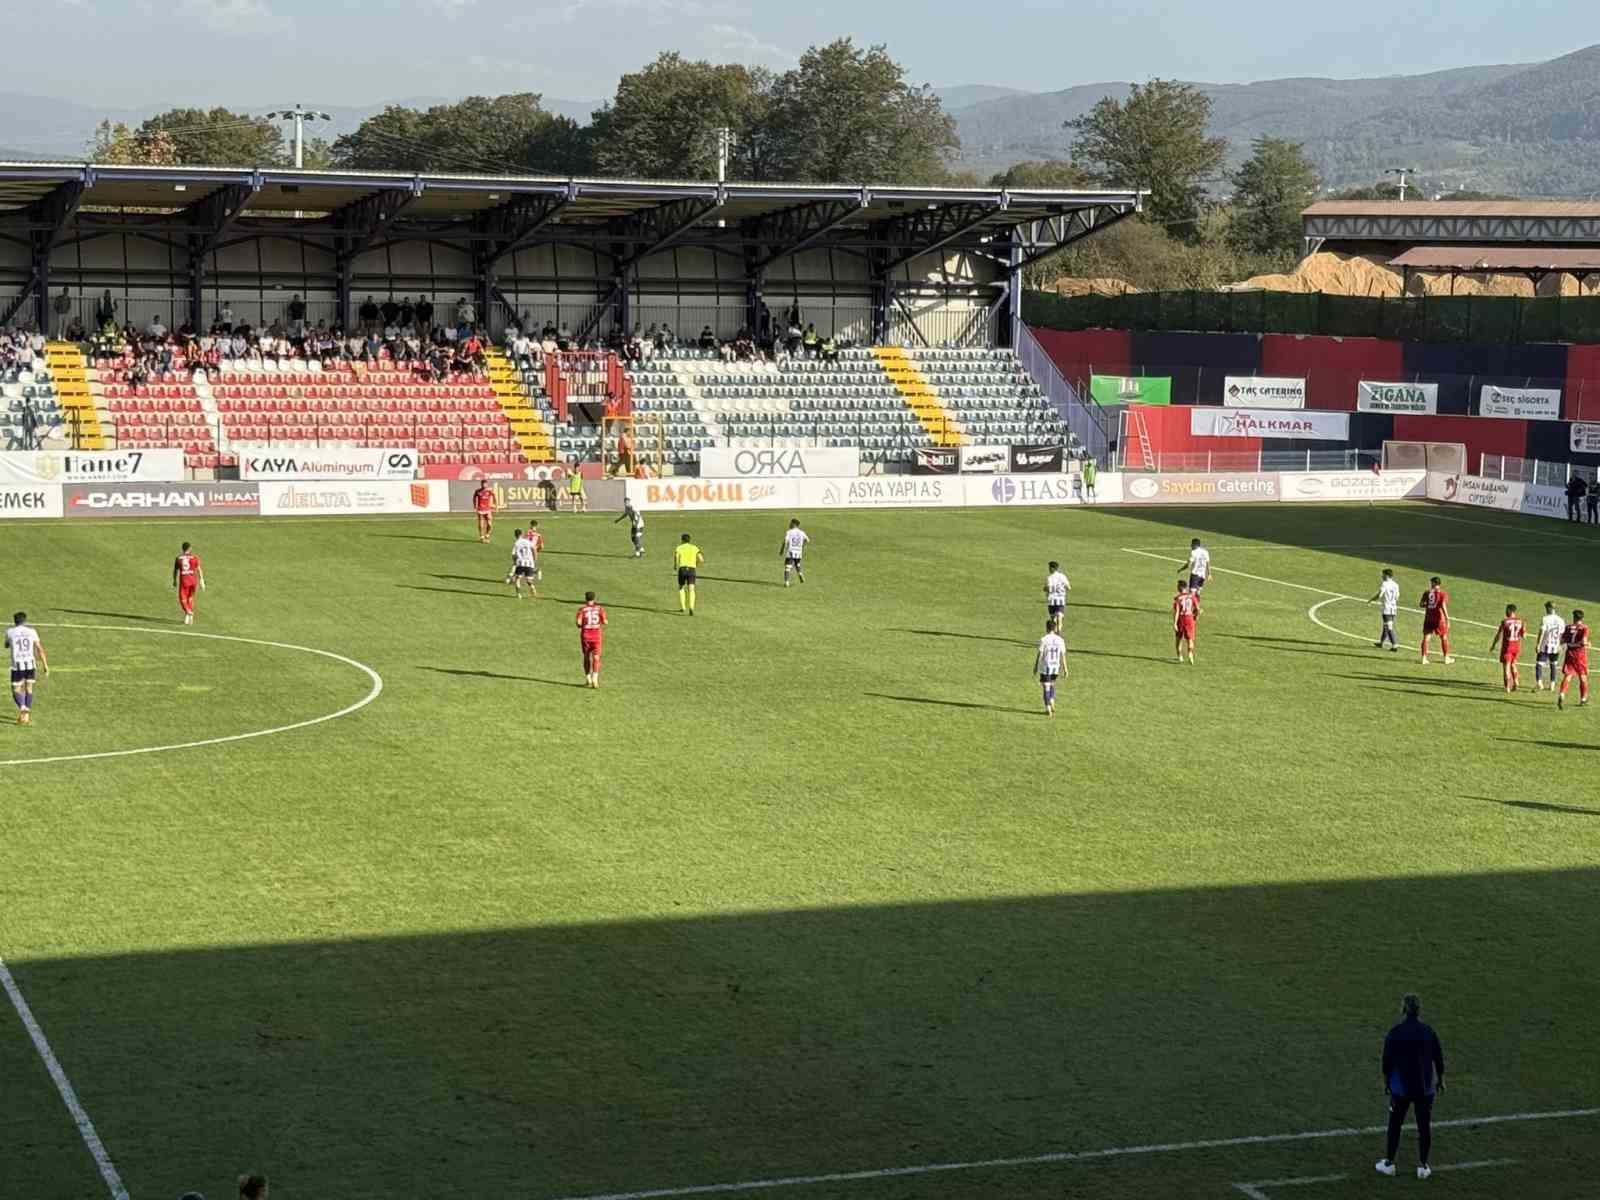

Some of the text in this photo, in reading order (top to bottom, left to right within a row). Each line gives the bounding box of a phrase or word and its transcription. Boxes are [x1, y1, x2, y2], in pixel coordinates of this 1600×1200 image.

[1259, 387, 1303, 396] CATERING
[1235, 419, 1313, 431] HALKMAR
[246, 458, 298, 473] KAYA
[848, 481, 884, 498] ASYA
[887, 481, 917, 497] YAPI
[1162, 478, 1275, 497] Saydam Catering
[0, 492, 45, 508] MEK
[585, 610, 600, 626] 15
[15, 638, 30, 653] 19
